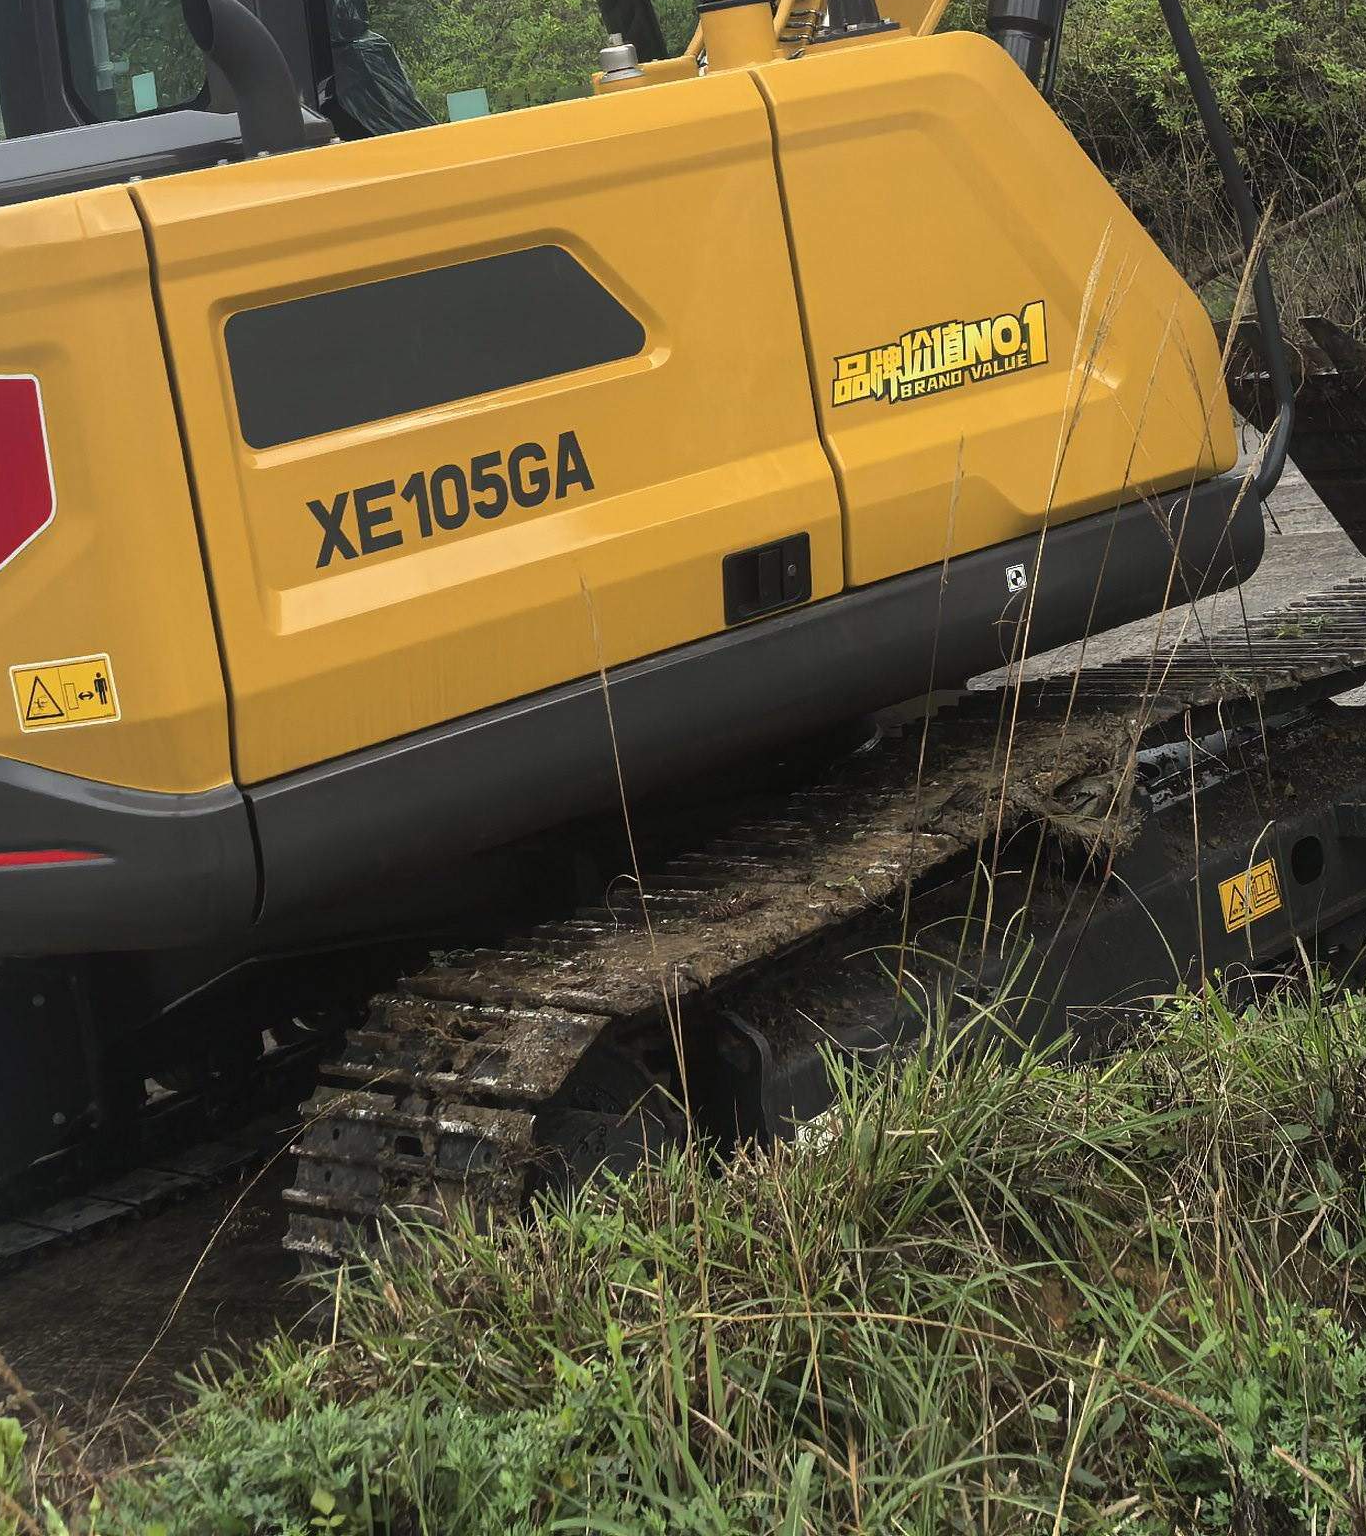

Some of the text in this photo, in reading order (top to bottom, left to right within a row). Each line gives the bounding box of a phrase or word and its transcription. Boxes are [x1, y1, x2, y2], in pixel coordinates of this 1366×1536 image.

[900, 353, 1029, 399] BRAND VALUE
[305, 430, 595, 569] XE105GA
